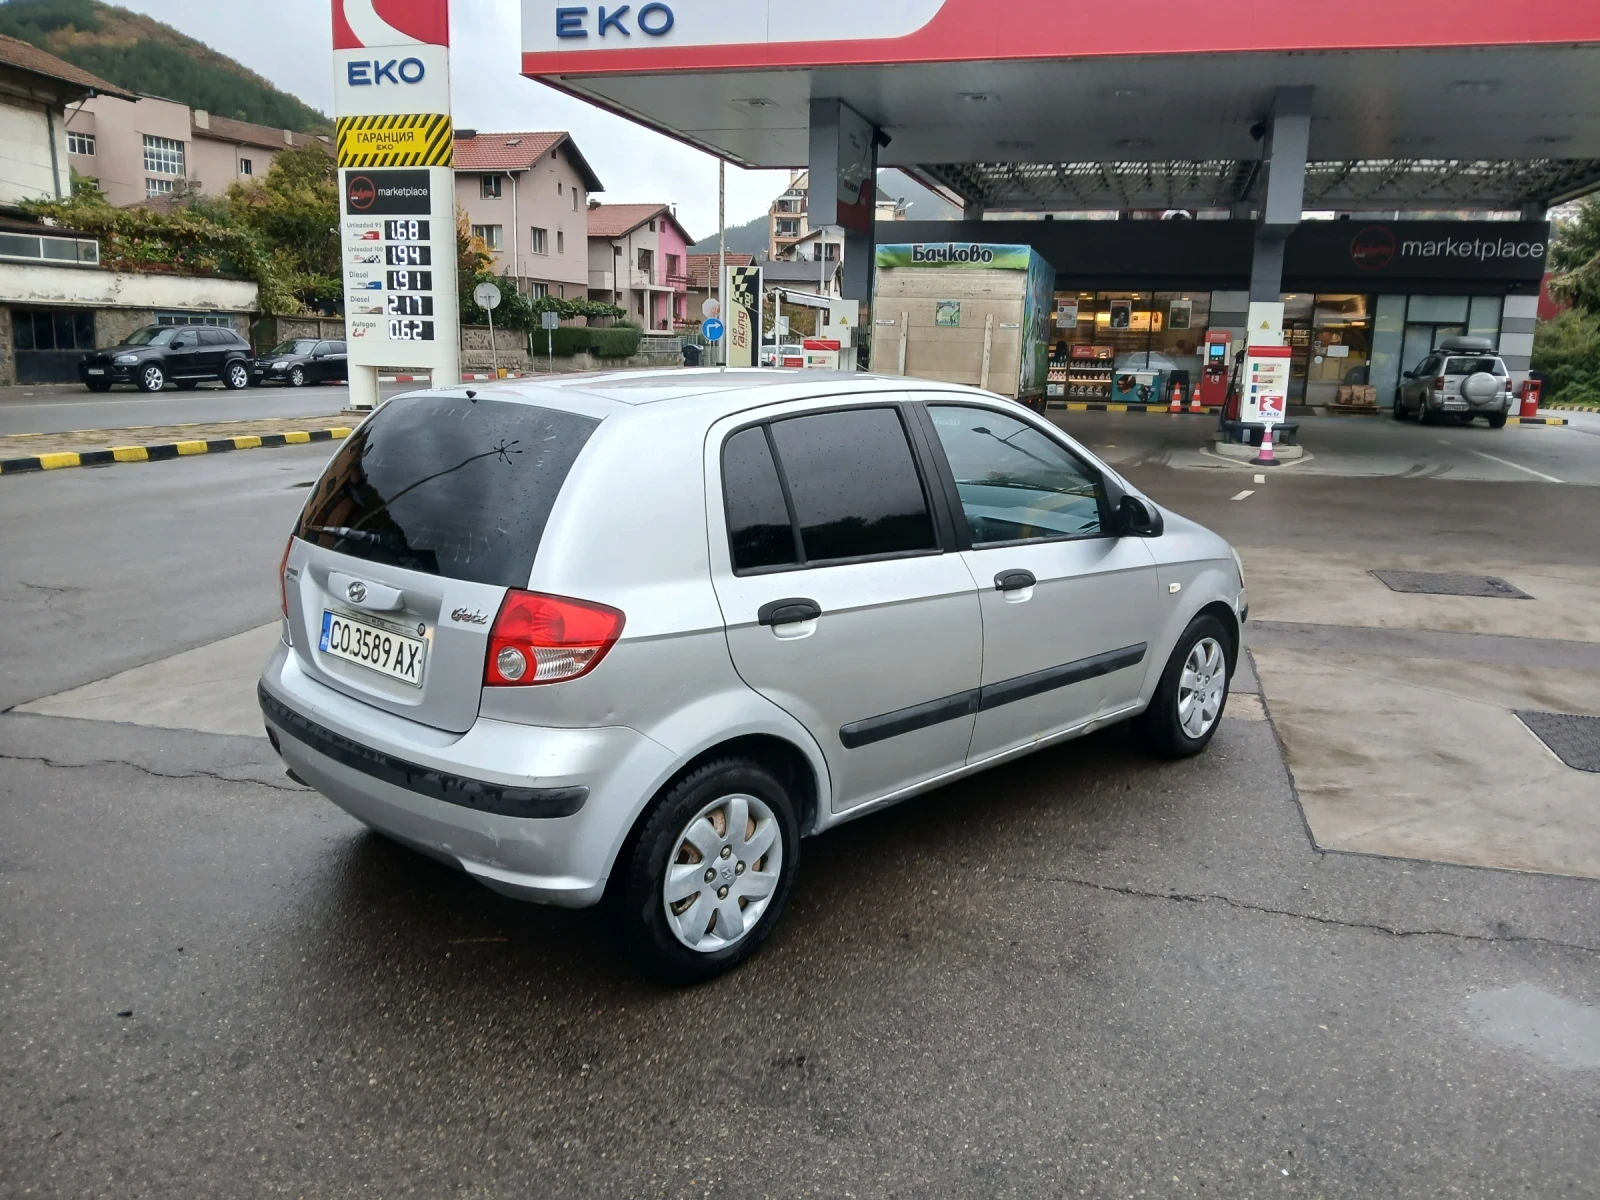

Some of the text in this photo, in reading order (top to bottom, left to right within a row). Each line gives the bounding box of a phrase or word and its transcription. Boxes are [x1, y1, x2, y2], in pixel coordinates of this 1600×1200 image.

[556, 2, 675, 37] EKO
[347, 57, 425, 86] EKO
[357, 131, 414, 144] ГАРАНЦИЯ
[378, 186, 428, 198] marketplace
[391, 220, 419, 240] 1.68
[392, 245, 420, 265] 1.94
[911, 243, 993, 265] Бачково
[1401, 237, 1544, 261] marketplace
[393, 270, 421, 290] 1.91
[388, 295, 422, 315] 2.17
[352, 321, 377, 329] Autogas
[389, 319, 423, 340] 0.62
[738, 310, 748, 348] racing
